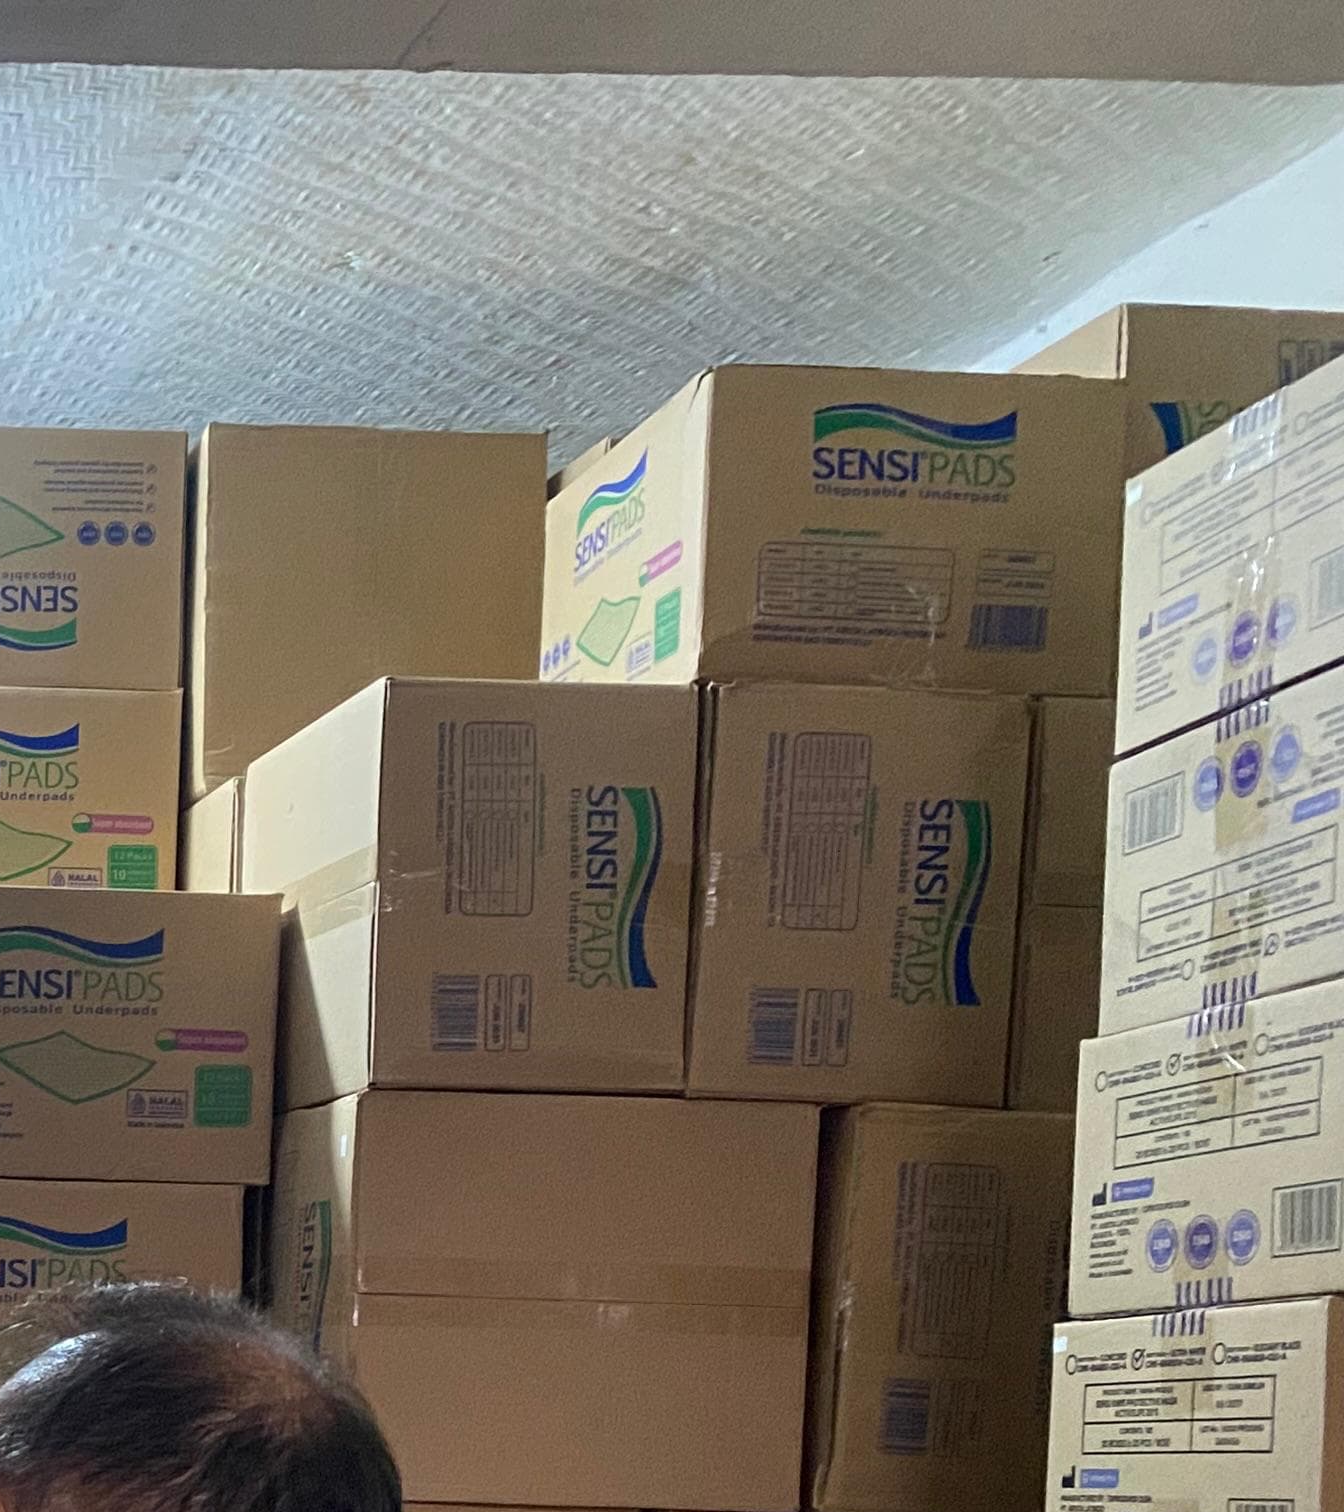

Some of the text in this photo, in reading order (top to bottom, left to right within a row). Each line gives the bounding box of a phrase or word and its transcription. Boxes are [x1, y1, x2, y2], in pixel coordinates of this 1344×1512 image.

[813, 448, 1017, 488] SENSI PADS
[815, 484, 1009, 504] Disposable Underpads
[574, 487, 646, 573] SENSI PADS
[2, 571, 77, 583] Disposable
[8, 760, 79, 789] PADS
[0, 791, 75, 802] Underpads
[578, 786, 620, 989] SENSI PADS
[902, 799, 954, 1006] SENSI PADS
[85, 969, 164, 1002] PADS
[73, 1004, 159, 1017] Underpads
[46, 1258, 127, 1288] PADS
